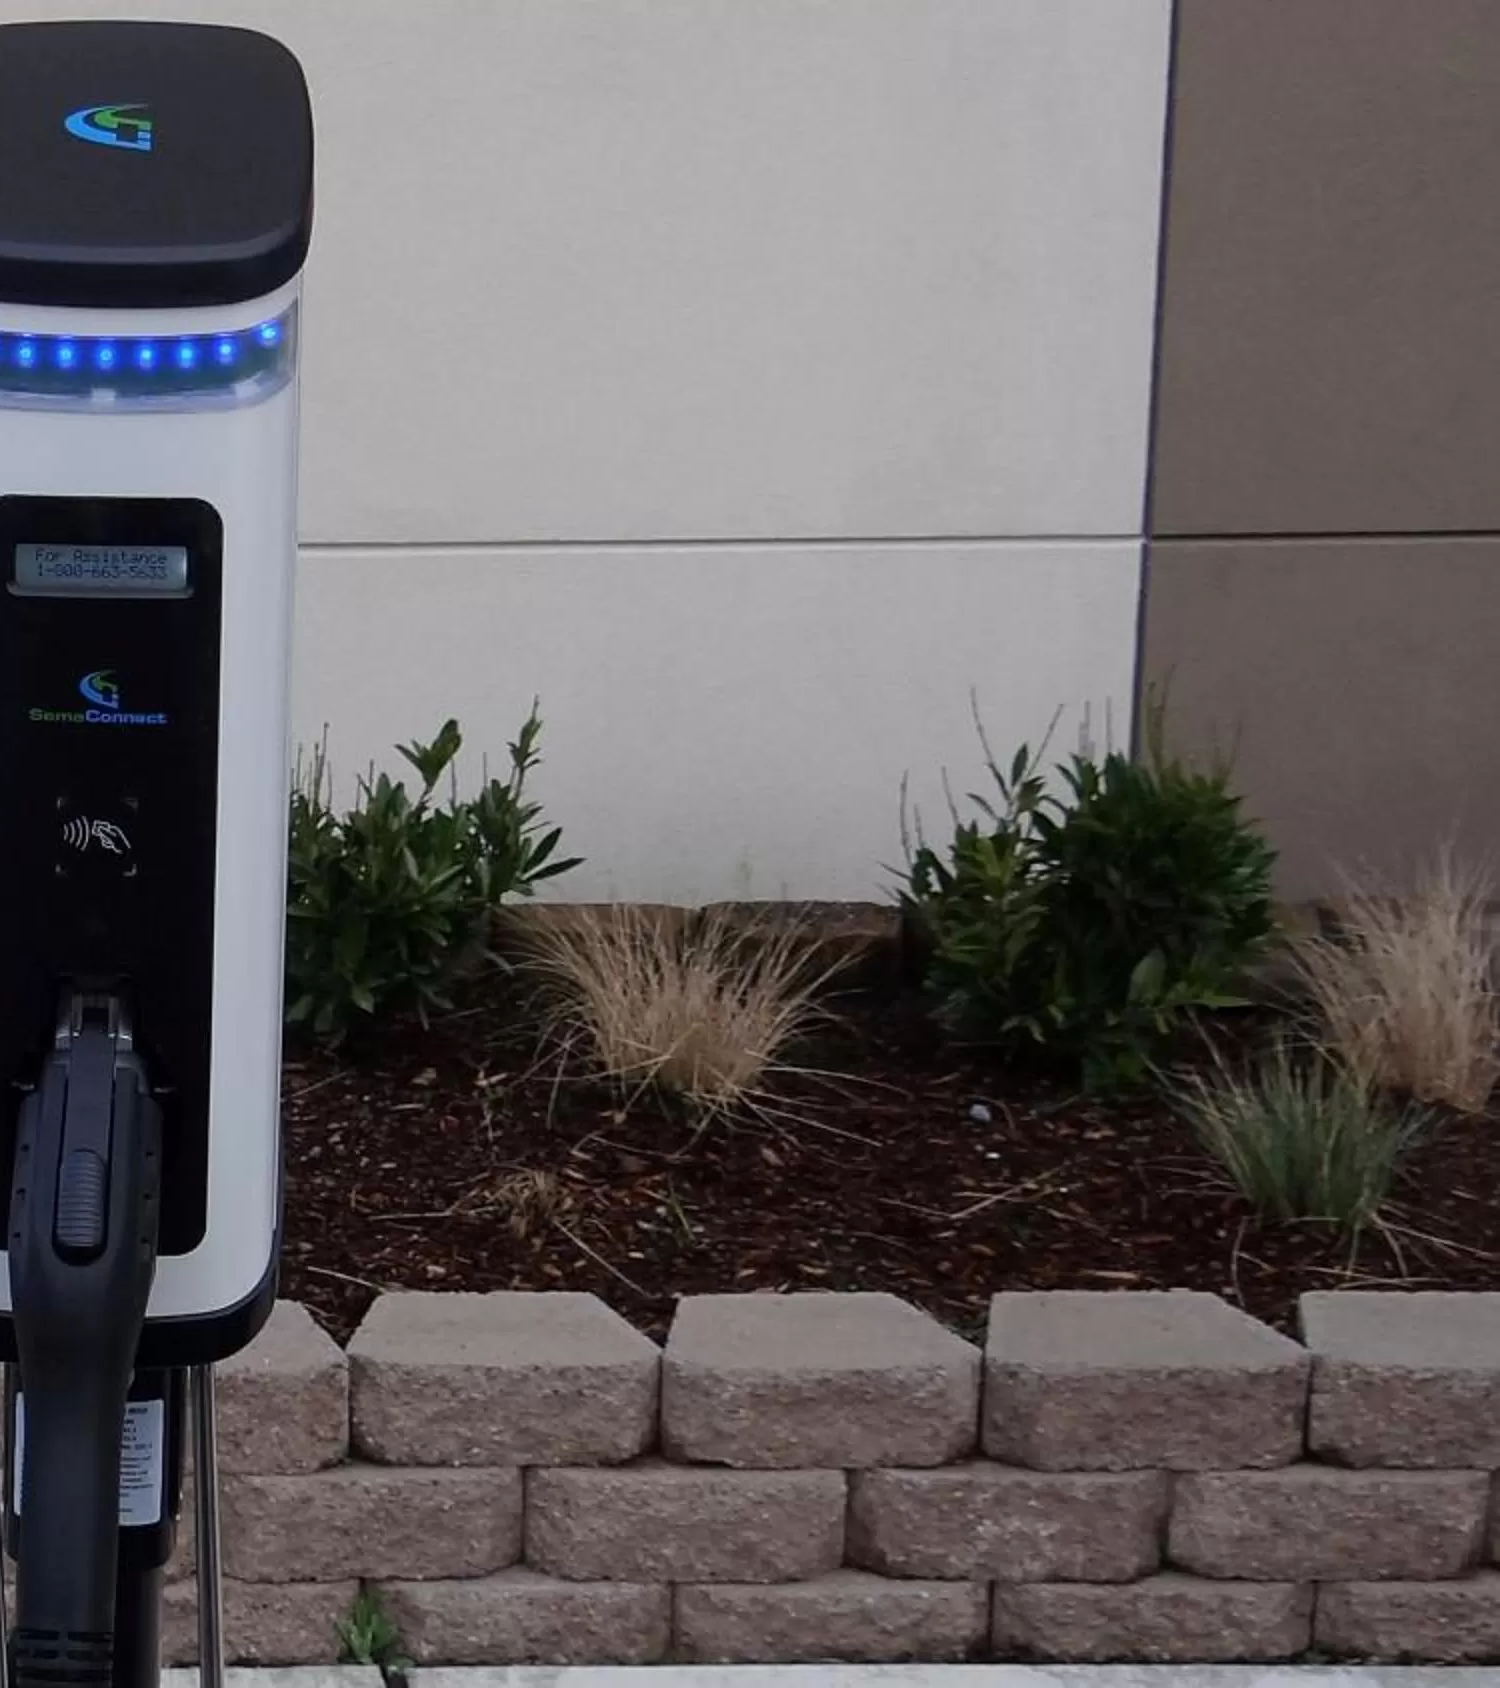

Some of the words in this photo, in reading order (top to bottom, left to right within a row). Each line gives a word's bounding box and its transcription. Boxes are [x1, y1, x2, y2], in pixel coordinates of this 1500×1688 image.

[35, 548, 61, 562] For
[73, 549, 168, 565] Assistance
[28, 707, 167, 725] SemaConnect
